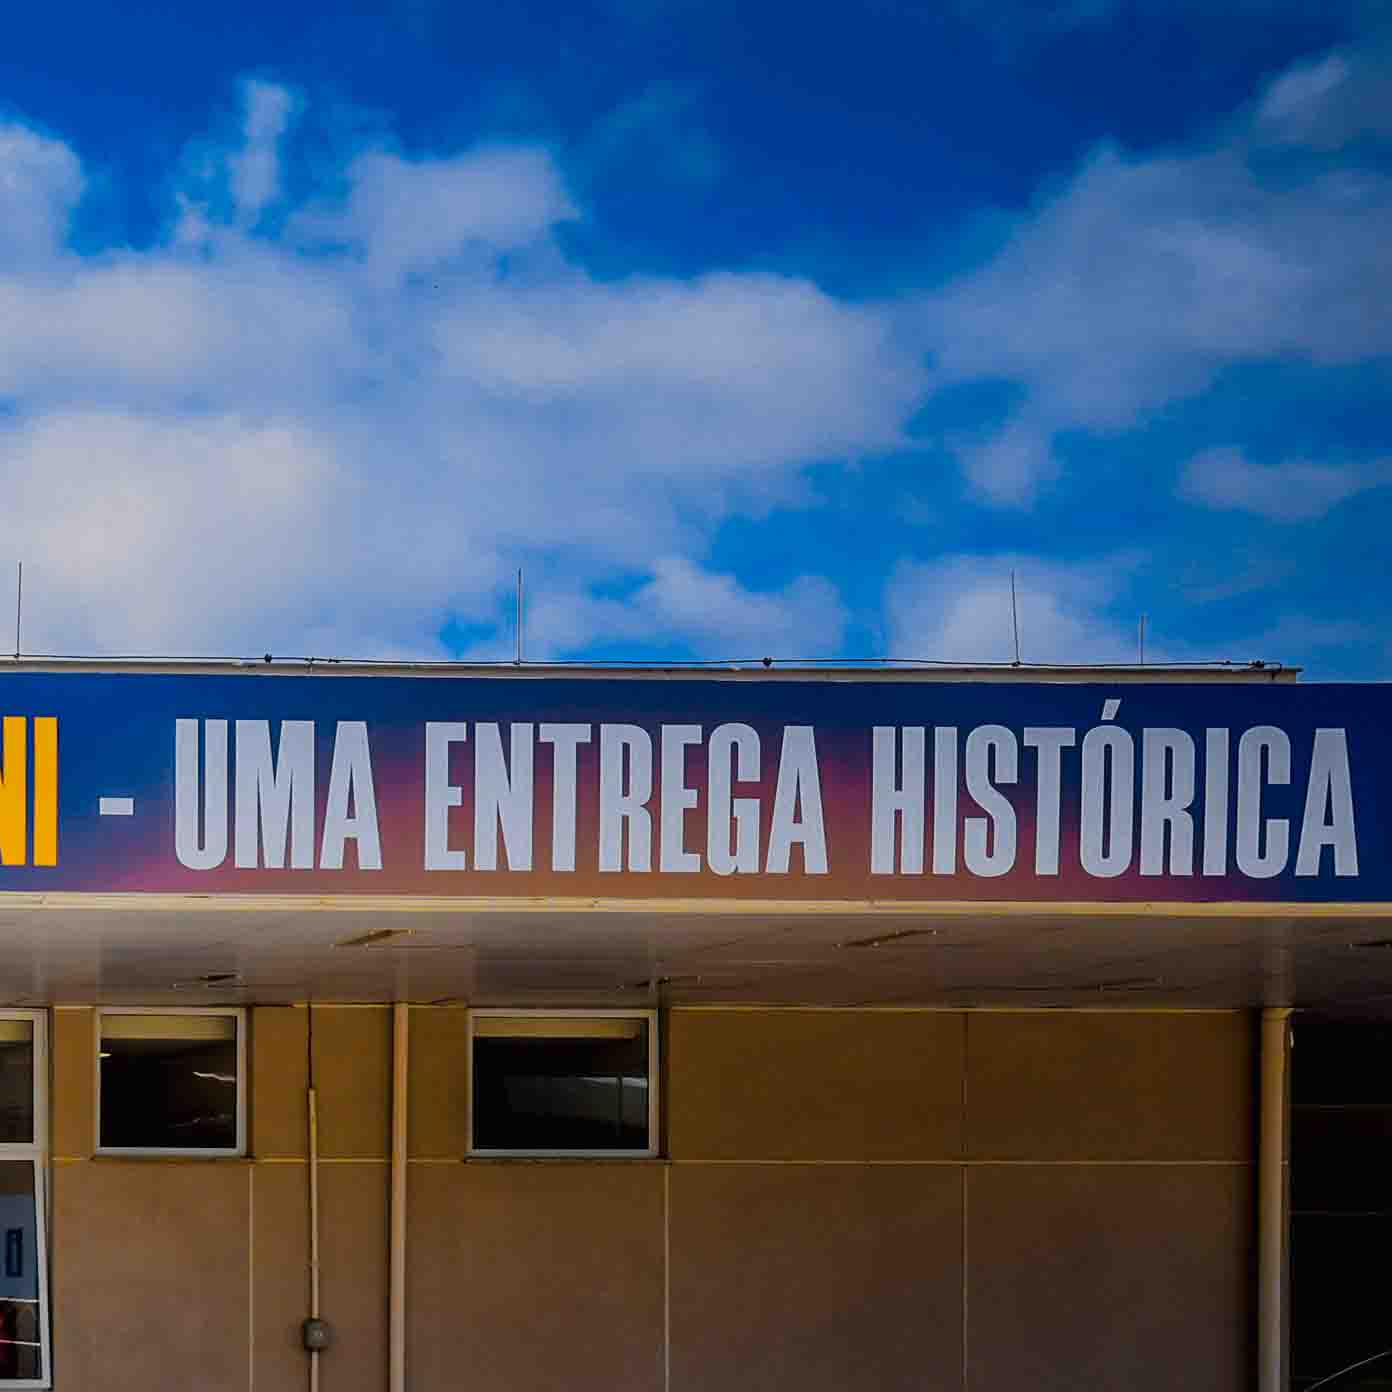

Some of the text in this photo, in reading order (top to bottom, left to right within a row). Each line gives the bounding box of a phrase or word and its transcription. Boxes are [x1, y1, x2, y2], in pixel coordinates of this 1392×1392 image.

[176, 718, 383, 872] UMA
[424, 722, 829, 876] ENTREGA
[871, 699, 1360, 879] HISTÓRICA
